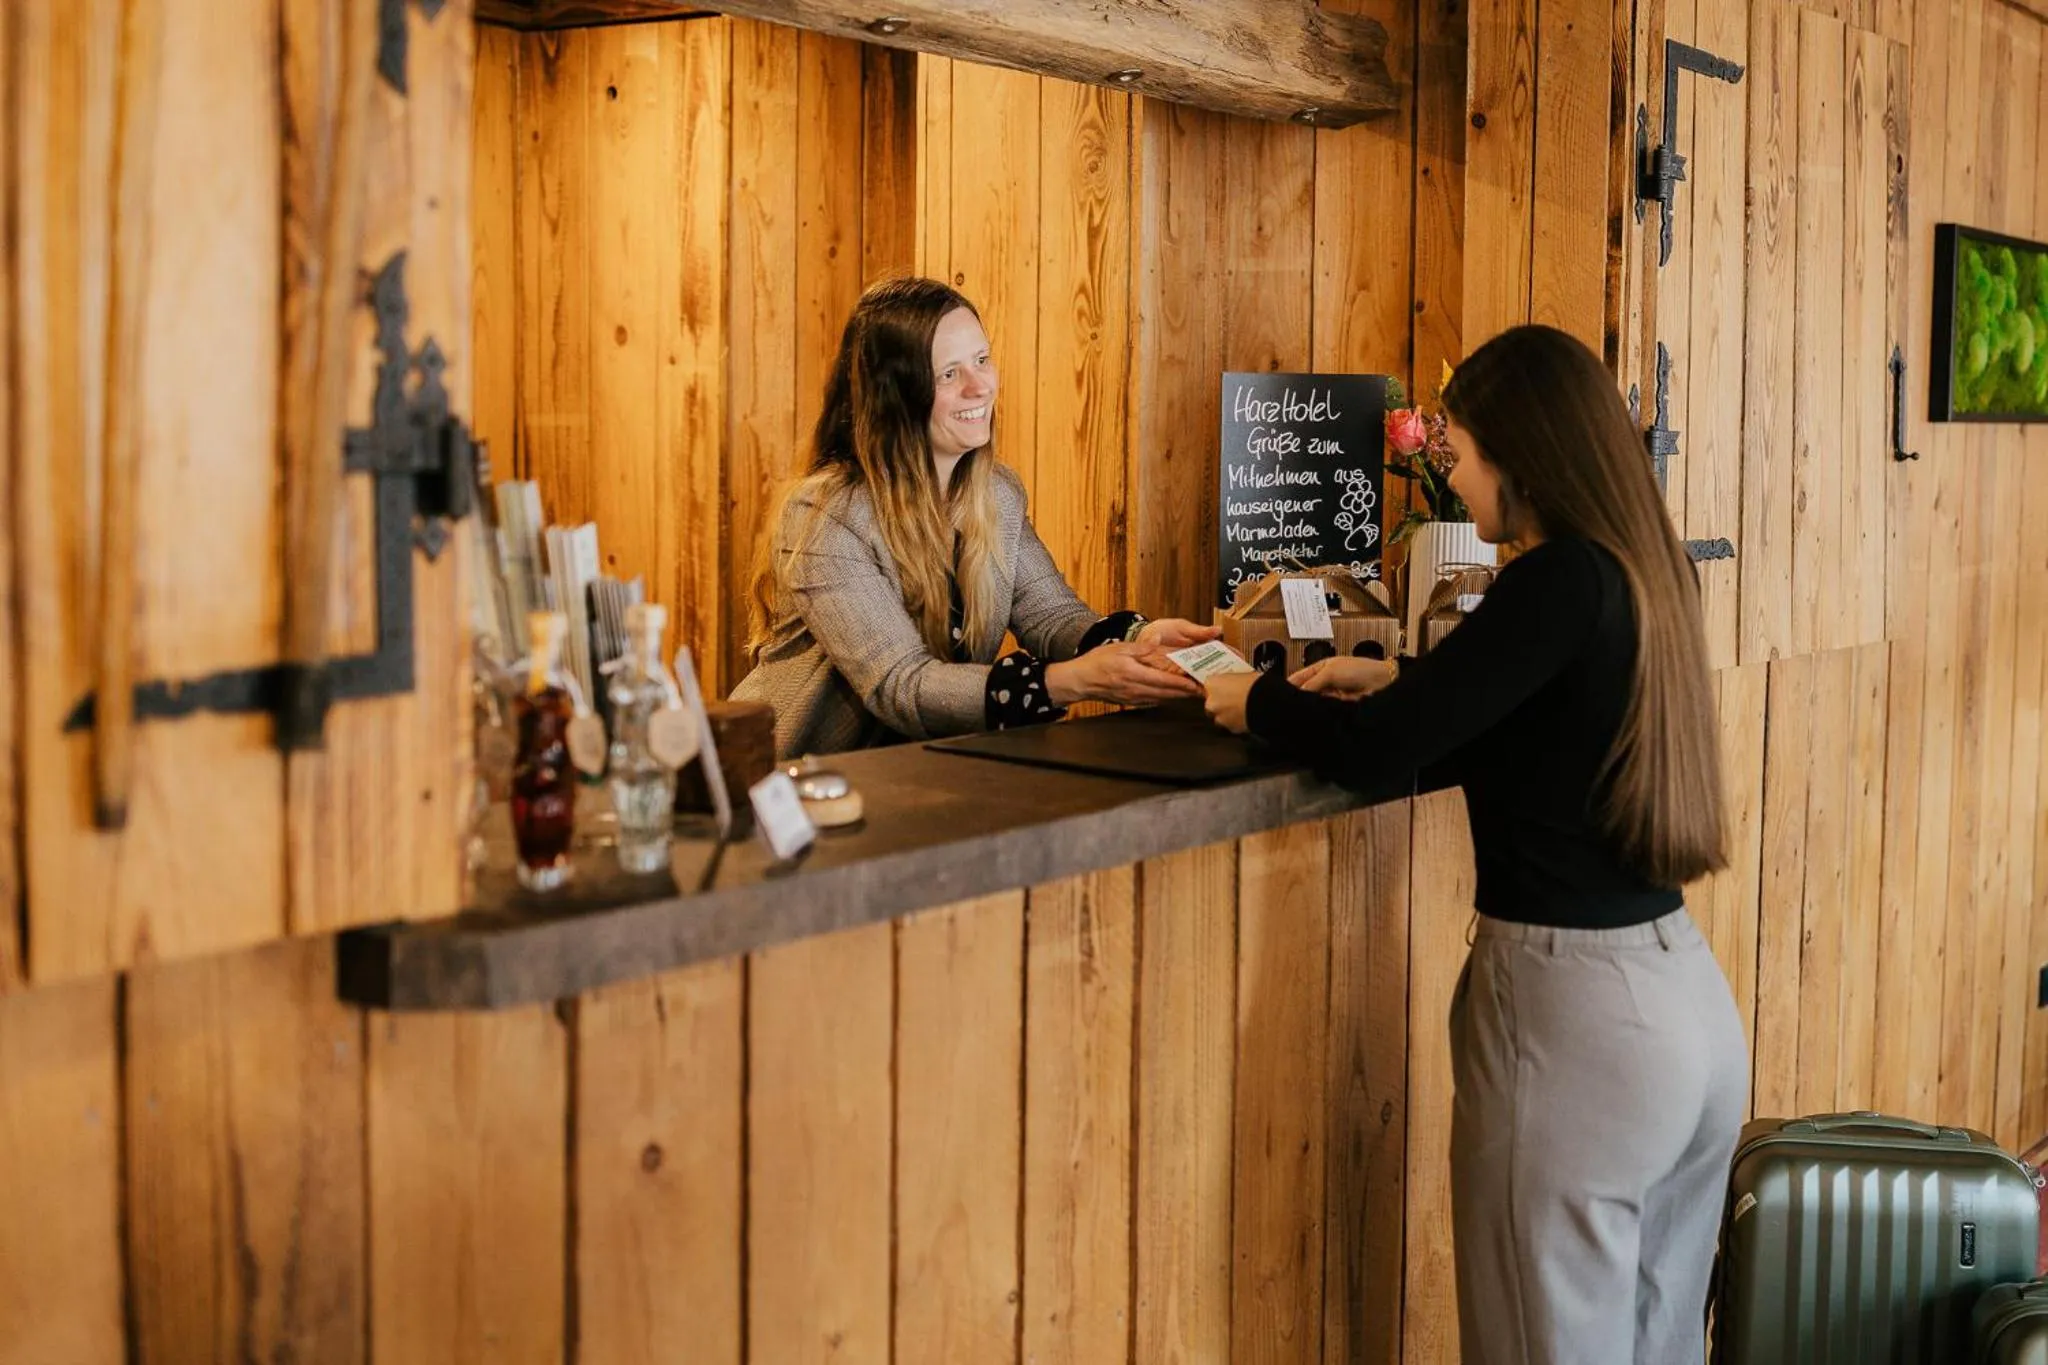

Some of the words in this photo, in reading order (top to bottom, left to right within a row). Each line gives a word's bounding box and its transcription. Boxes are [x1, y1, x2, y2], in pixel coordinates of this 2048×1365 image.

[1247, 426, 1301, 461] Grüße
[1307, 437, 1345, 456] zum
[1227, 463, 1322, 490] Mitnehmen
[1334, 468, 1366, 485] aus
[1226, 496, 1323, 522] hauseigener
[1226, 518, 1320, 542] Marmeladen
